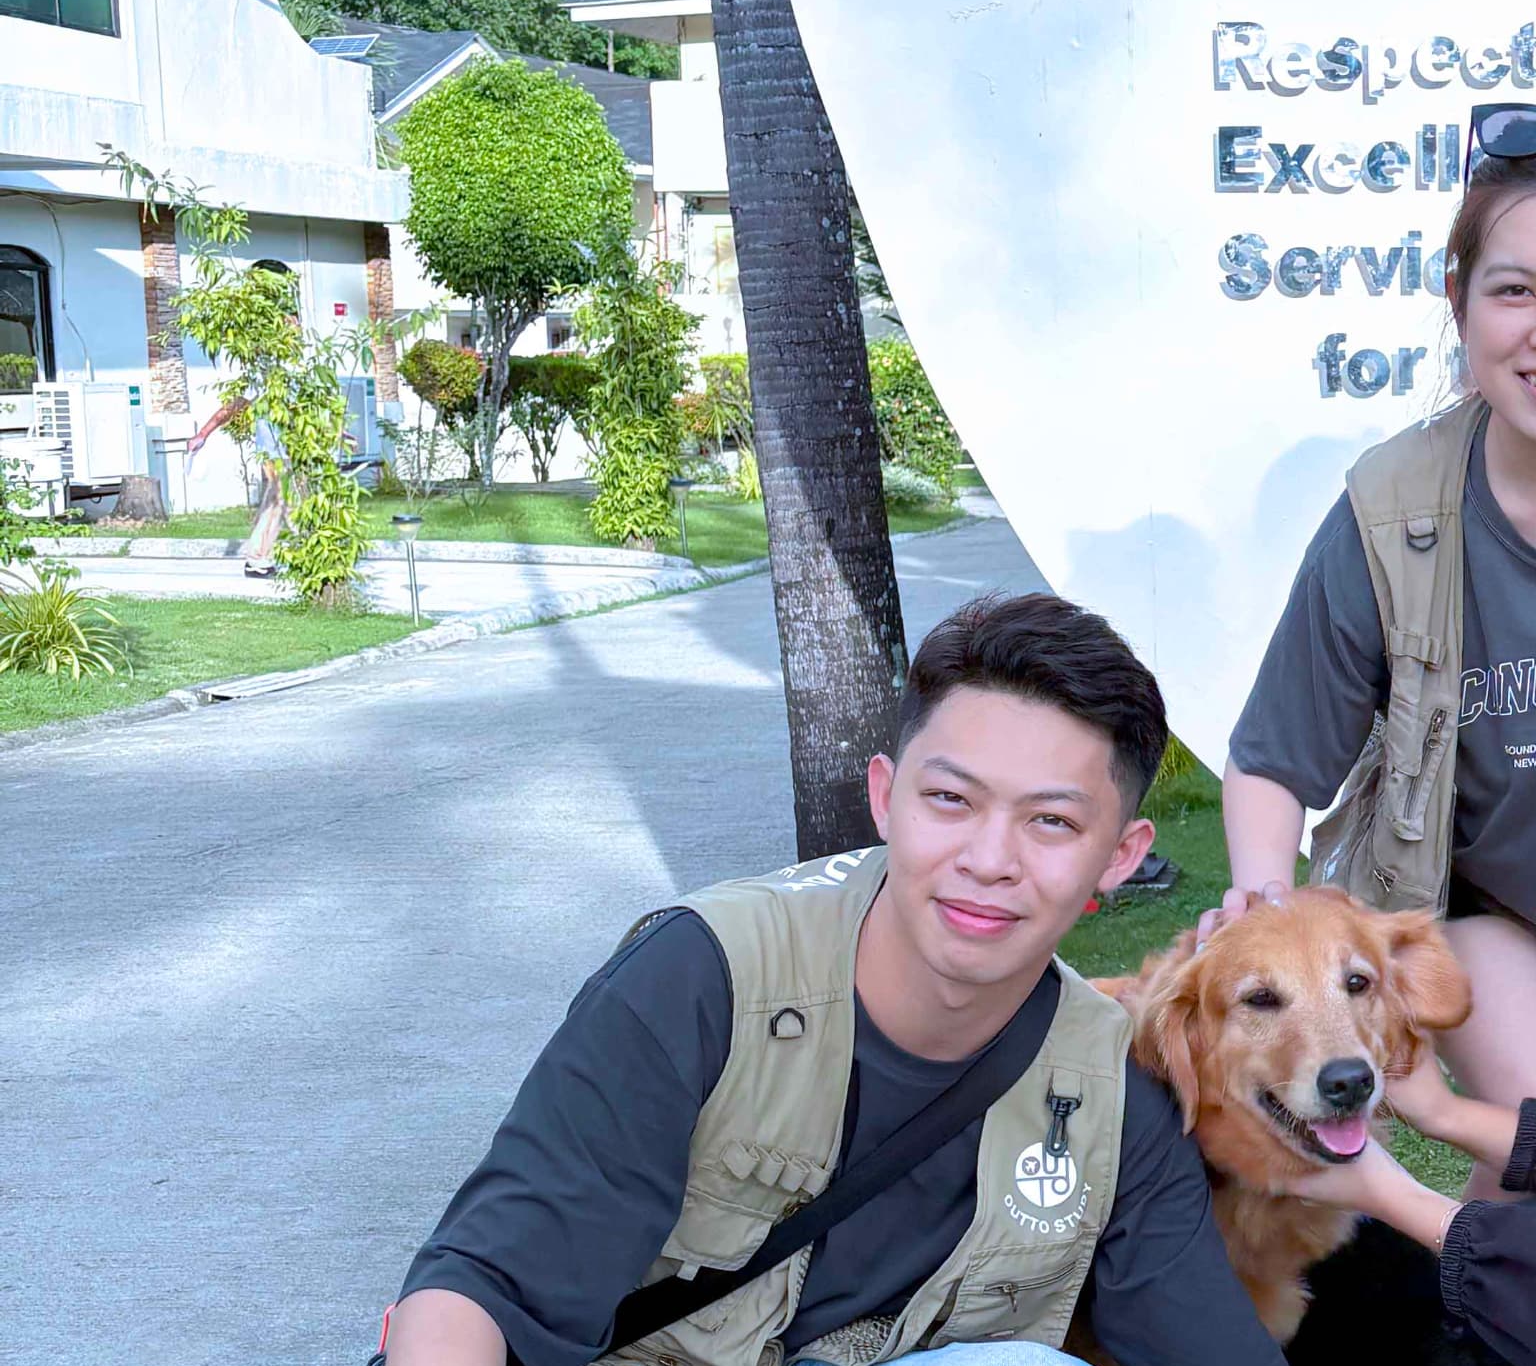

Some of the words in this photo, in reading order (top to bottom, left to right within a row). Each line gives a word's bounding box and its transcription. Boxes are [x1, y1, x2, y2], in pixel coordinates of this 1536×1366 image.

[1213, 124, 1484, 194] Excell
[1218, 230, 1449, 301] Servi
[1312, 333, 1428, 399] for
[1004, 1194, 1050, 1234] OUTTO
